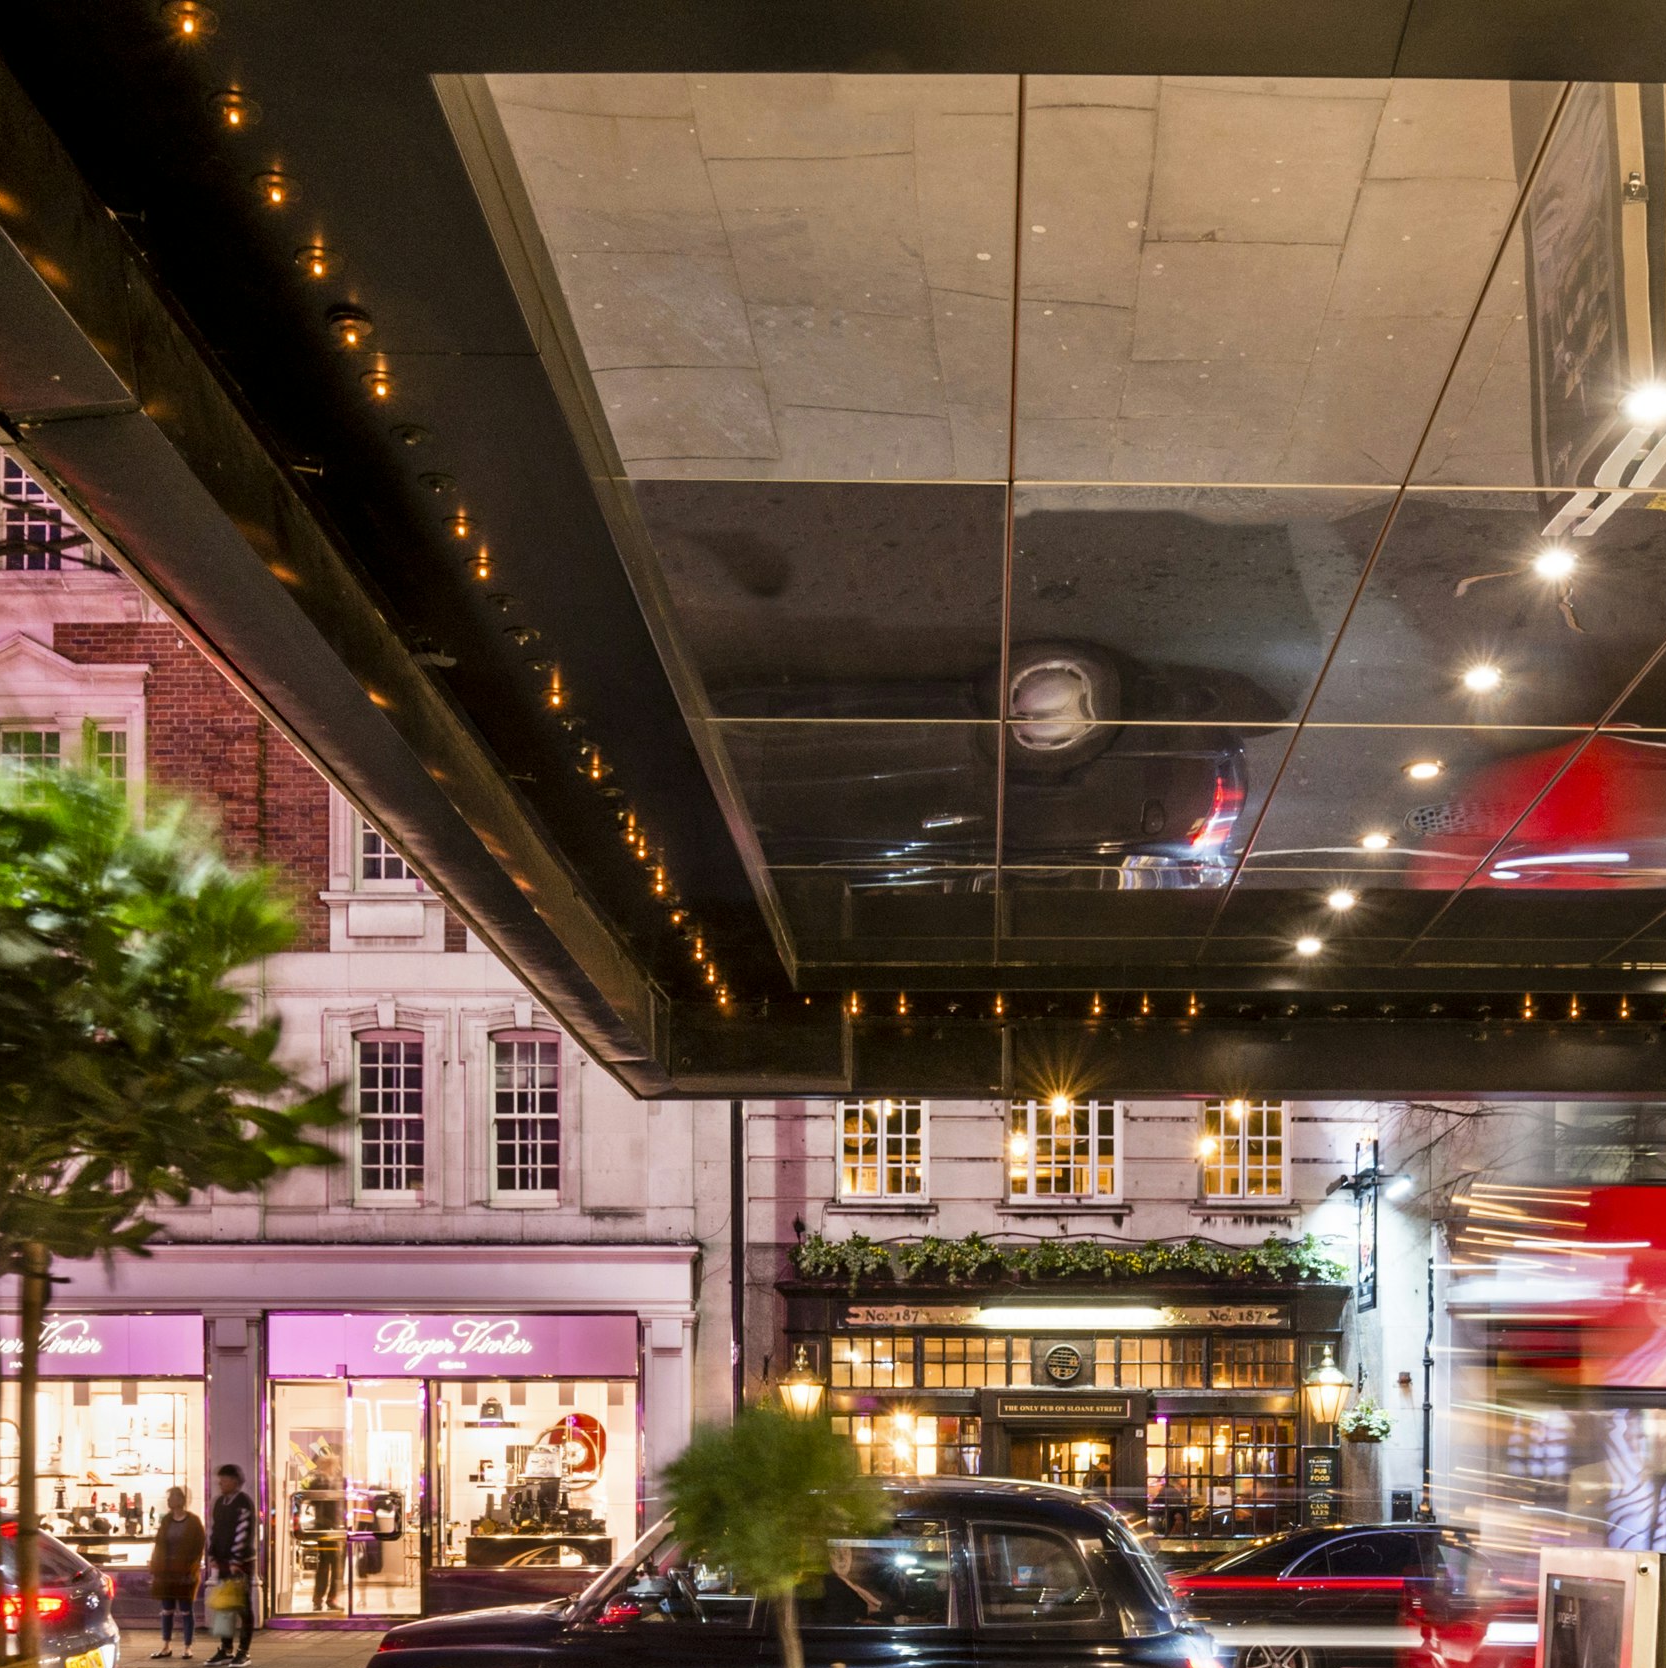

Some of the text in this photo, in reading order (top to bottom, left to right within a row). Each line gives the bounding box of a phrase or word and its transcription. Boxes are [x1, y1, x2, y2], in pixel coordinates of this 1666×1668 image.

[895, 1310, 920, 1322] 187
[1239, 1310, 1263, 1322] 187
[373, 1319, 533, 1371] Roger Vivier
